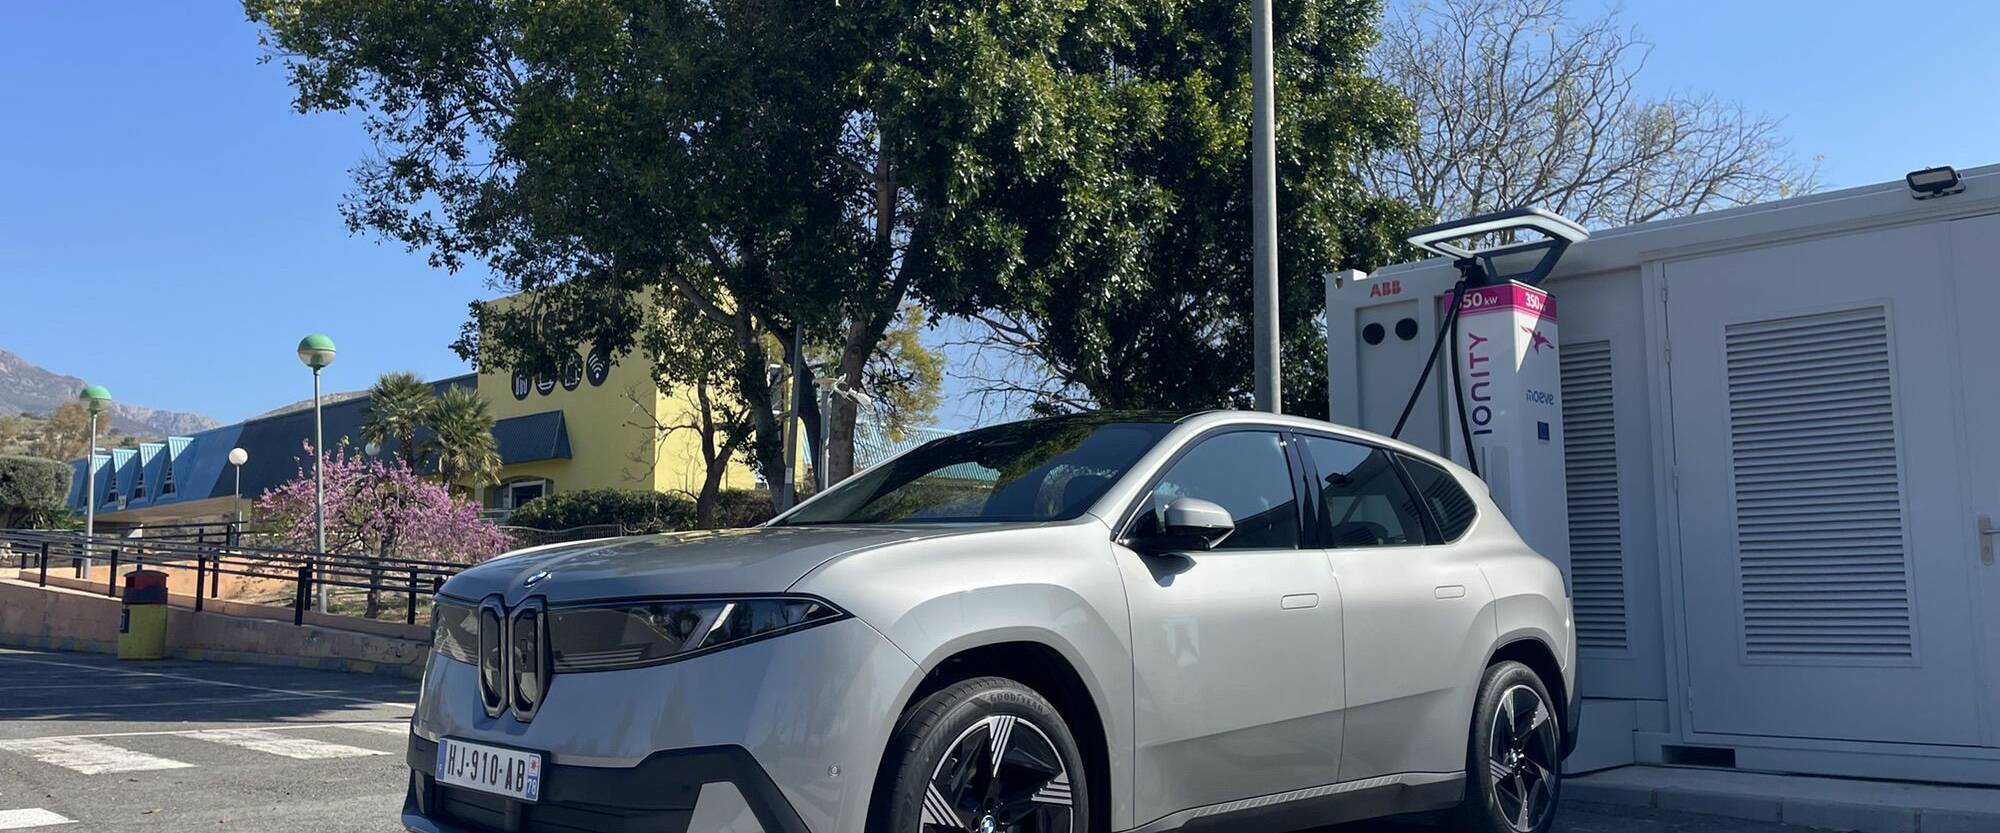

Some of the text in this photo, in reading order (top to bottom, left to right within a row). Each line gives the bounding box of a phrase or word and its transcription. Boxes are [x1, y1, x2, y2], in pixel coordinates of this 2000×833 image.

[1370, 280, 1401, 297] ABB
[1459, 293, 1482, 309] 50
[1525, 292, 1540, 310] 350
[1468, 332, 1493, 435] IONITY
[990, 692, 1043, 712] GOODYEAR
[448, 744, 526, 792] HJ-910-AB
[527, 779, 537, 796] 78
